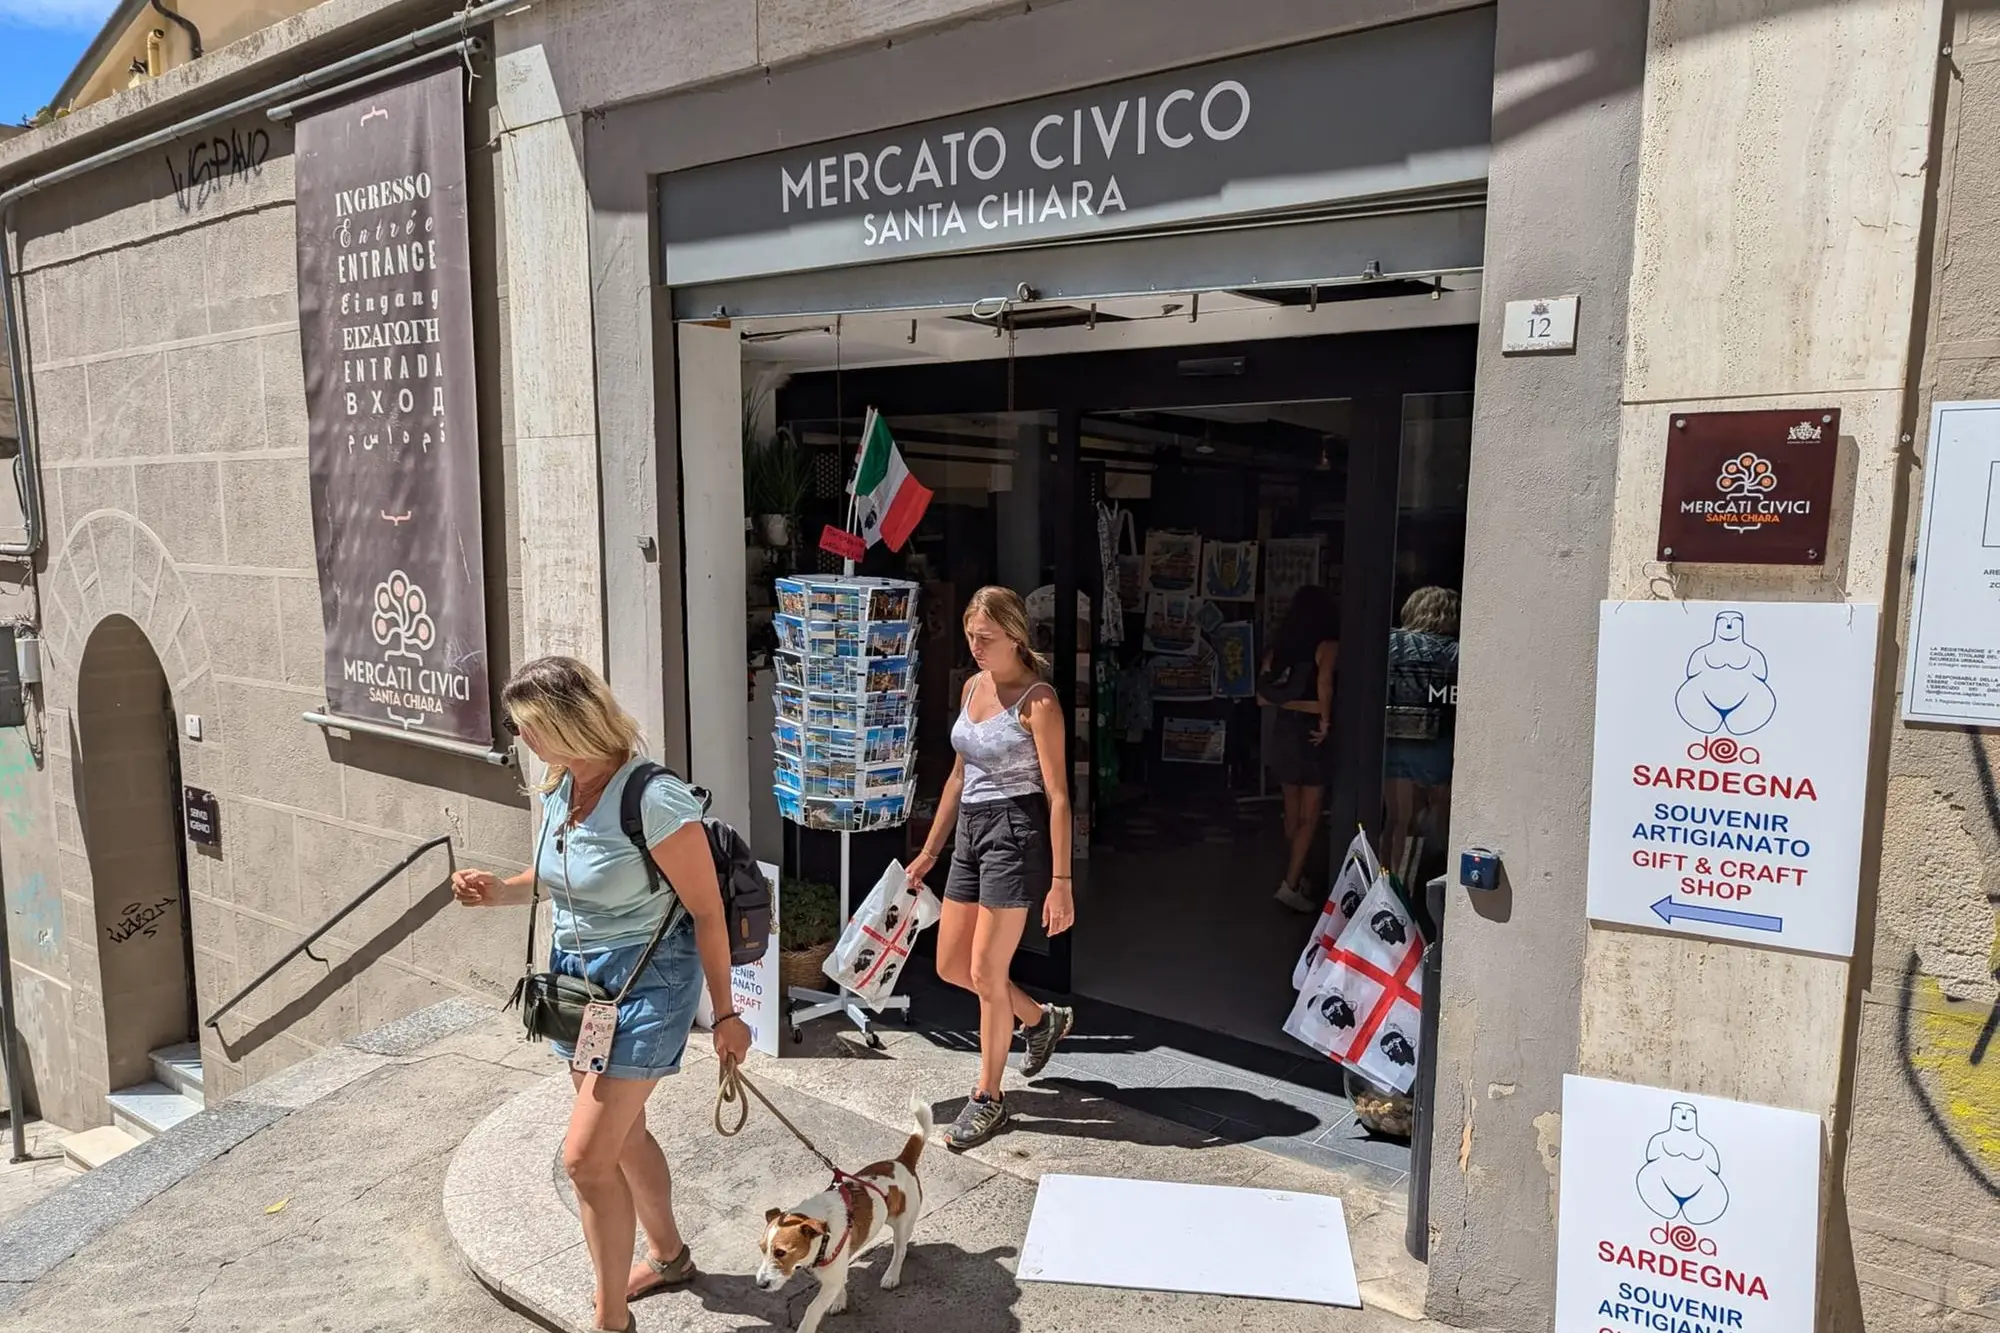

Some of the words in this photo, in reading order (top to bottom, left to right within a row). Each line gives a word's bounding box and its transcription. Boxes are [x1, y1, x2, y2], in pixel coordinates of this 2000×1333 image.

[781, 126, 1006, 213] MERCATO
[1030, 80, 1251, 170] CIVICO
[335, 172, 431, 217] INGRESSO
[863, 200, 967, 247] SANTA
[977, 174, 1127, 230] CHIARA
[333, 209, 433, 248] Entrée
[338, 239, 437, 283] ENTRANCE
[341, 288, 439, 316] Eingang
[1527, 317, 1551, 338] 12
[344, 352, 443, 383] ENTRADA
[346, 386, 445, 416] ВХОД
[1680, 500, 1751, 514] MERCATI
[1758, 500, 1811, 514] CIVICI
[1705, 513, 1738, 523] SANTA
[1741, 513, 1780, 523] CHIARA
[344, 657, 412, 691] MERCATI
[419, 669, 470, 701] CIVICI
[369, 687, 401, 707] SANTA
[403, 692, 444, 715] CHIARA
[1633, 765, 1817, 801] SARDEGNA
[1654, 803, 1788, 833] SOUVENIR
[1632, 823, 1810, 857] ARTIGIANATO
[1632, 849, 1688, 872] GIFT
[1695, 857, 1712, 875] &
[1720, 860, 1808, 886] CRAFT
[1681, 877, 1752, 901] SHOP
[733, 993, 762, 1011] CRAFT
[1598, 1241, 1769, 1300] SARDEGNA
[1618, 1282, 1743, 1328] SOUVENIR
